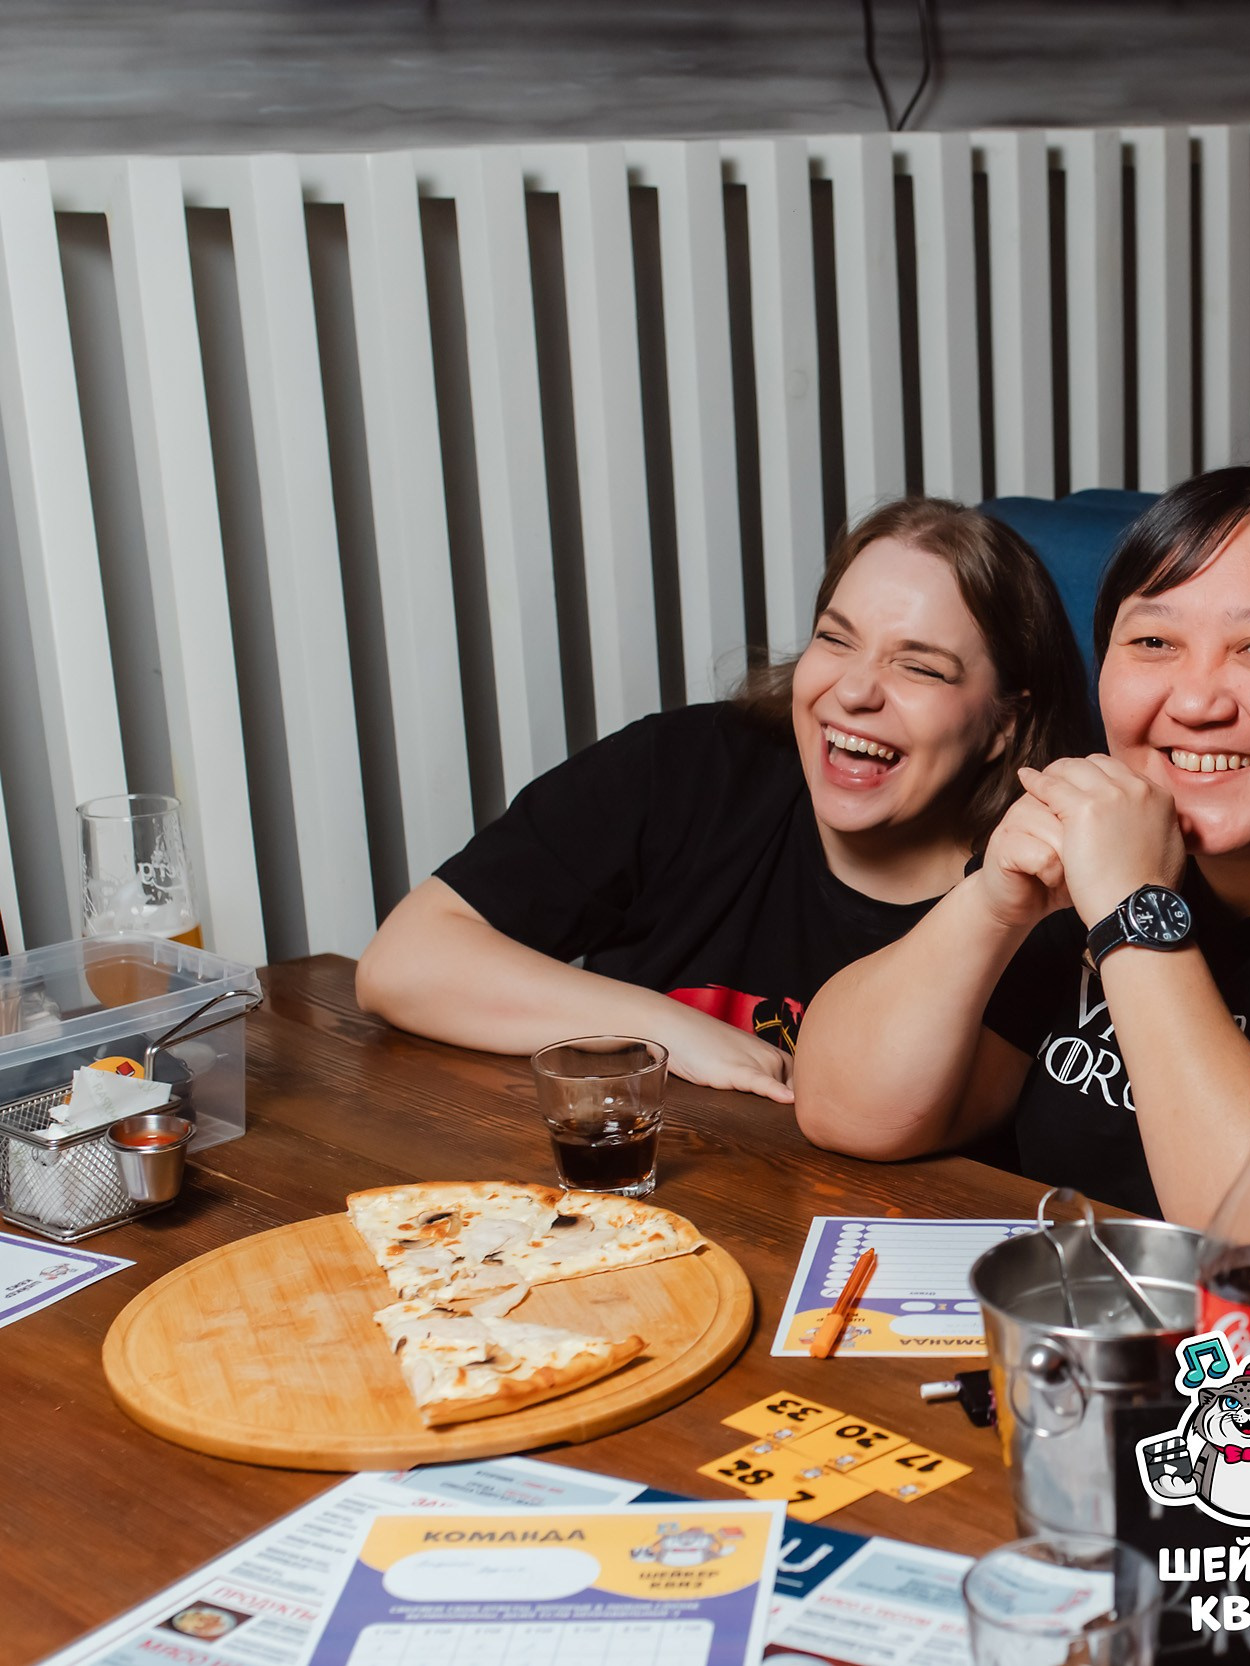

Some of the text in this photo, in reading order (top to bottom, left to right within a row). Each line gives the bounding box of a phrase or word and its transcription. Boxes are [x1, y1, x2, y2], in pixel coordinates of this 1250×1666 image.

[900, 1338, 986, 1346] ОМАНДА
[766, 1400, 823, 1422] 33
[835, 1424, 889, 1449] 20
[717, 1459, 774, 1485] 28
[895, 1454, 943, 1473] 17
[422, 1529, 586, 1543] КОМАНДА
